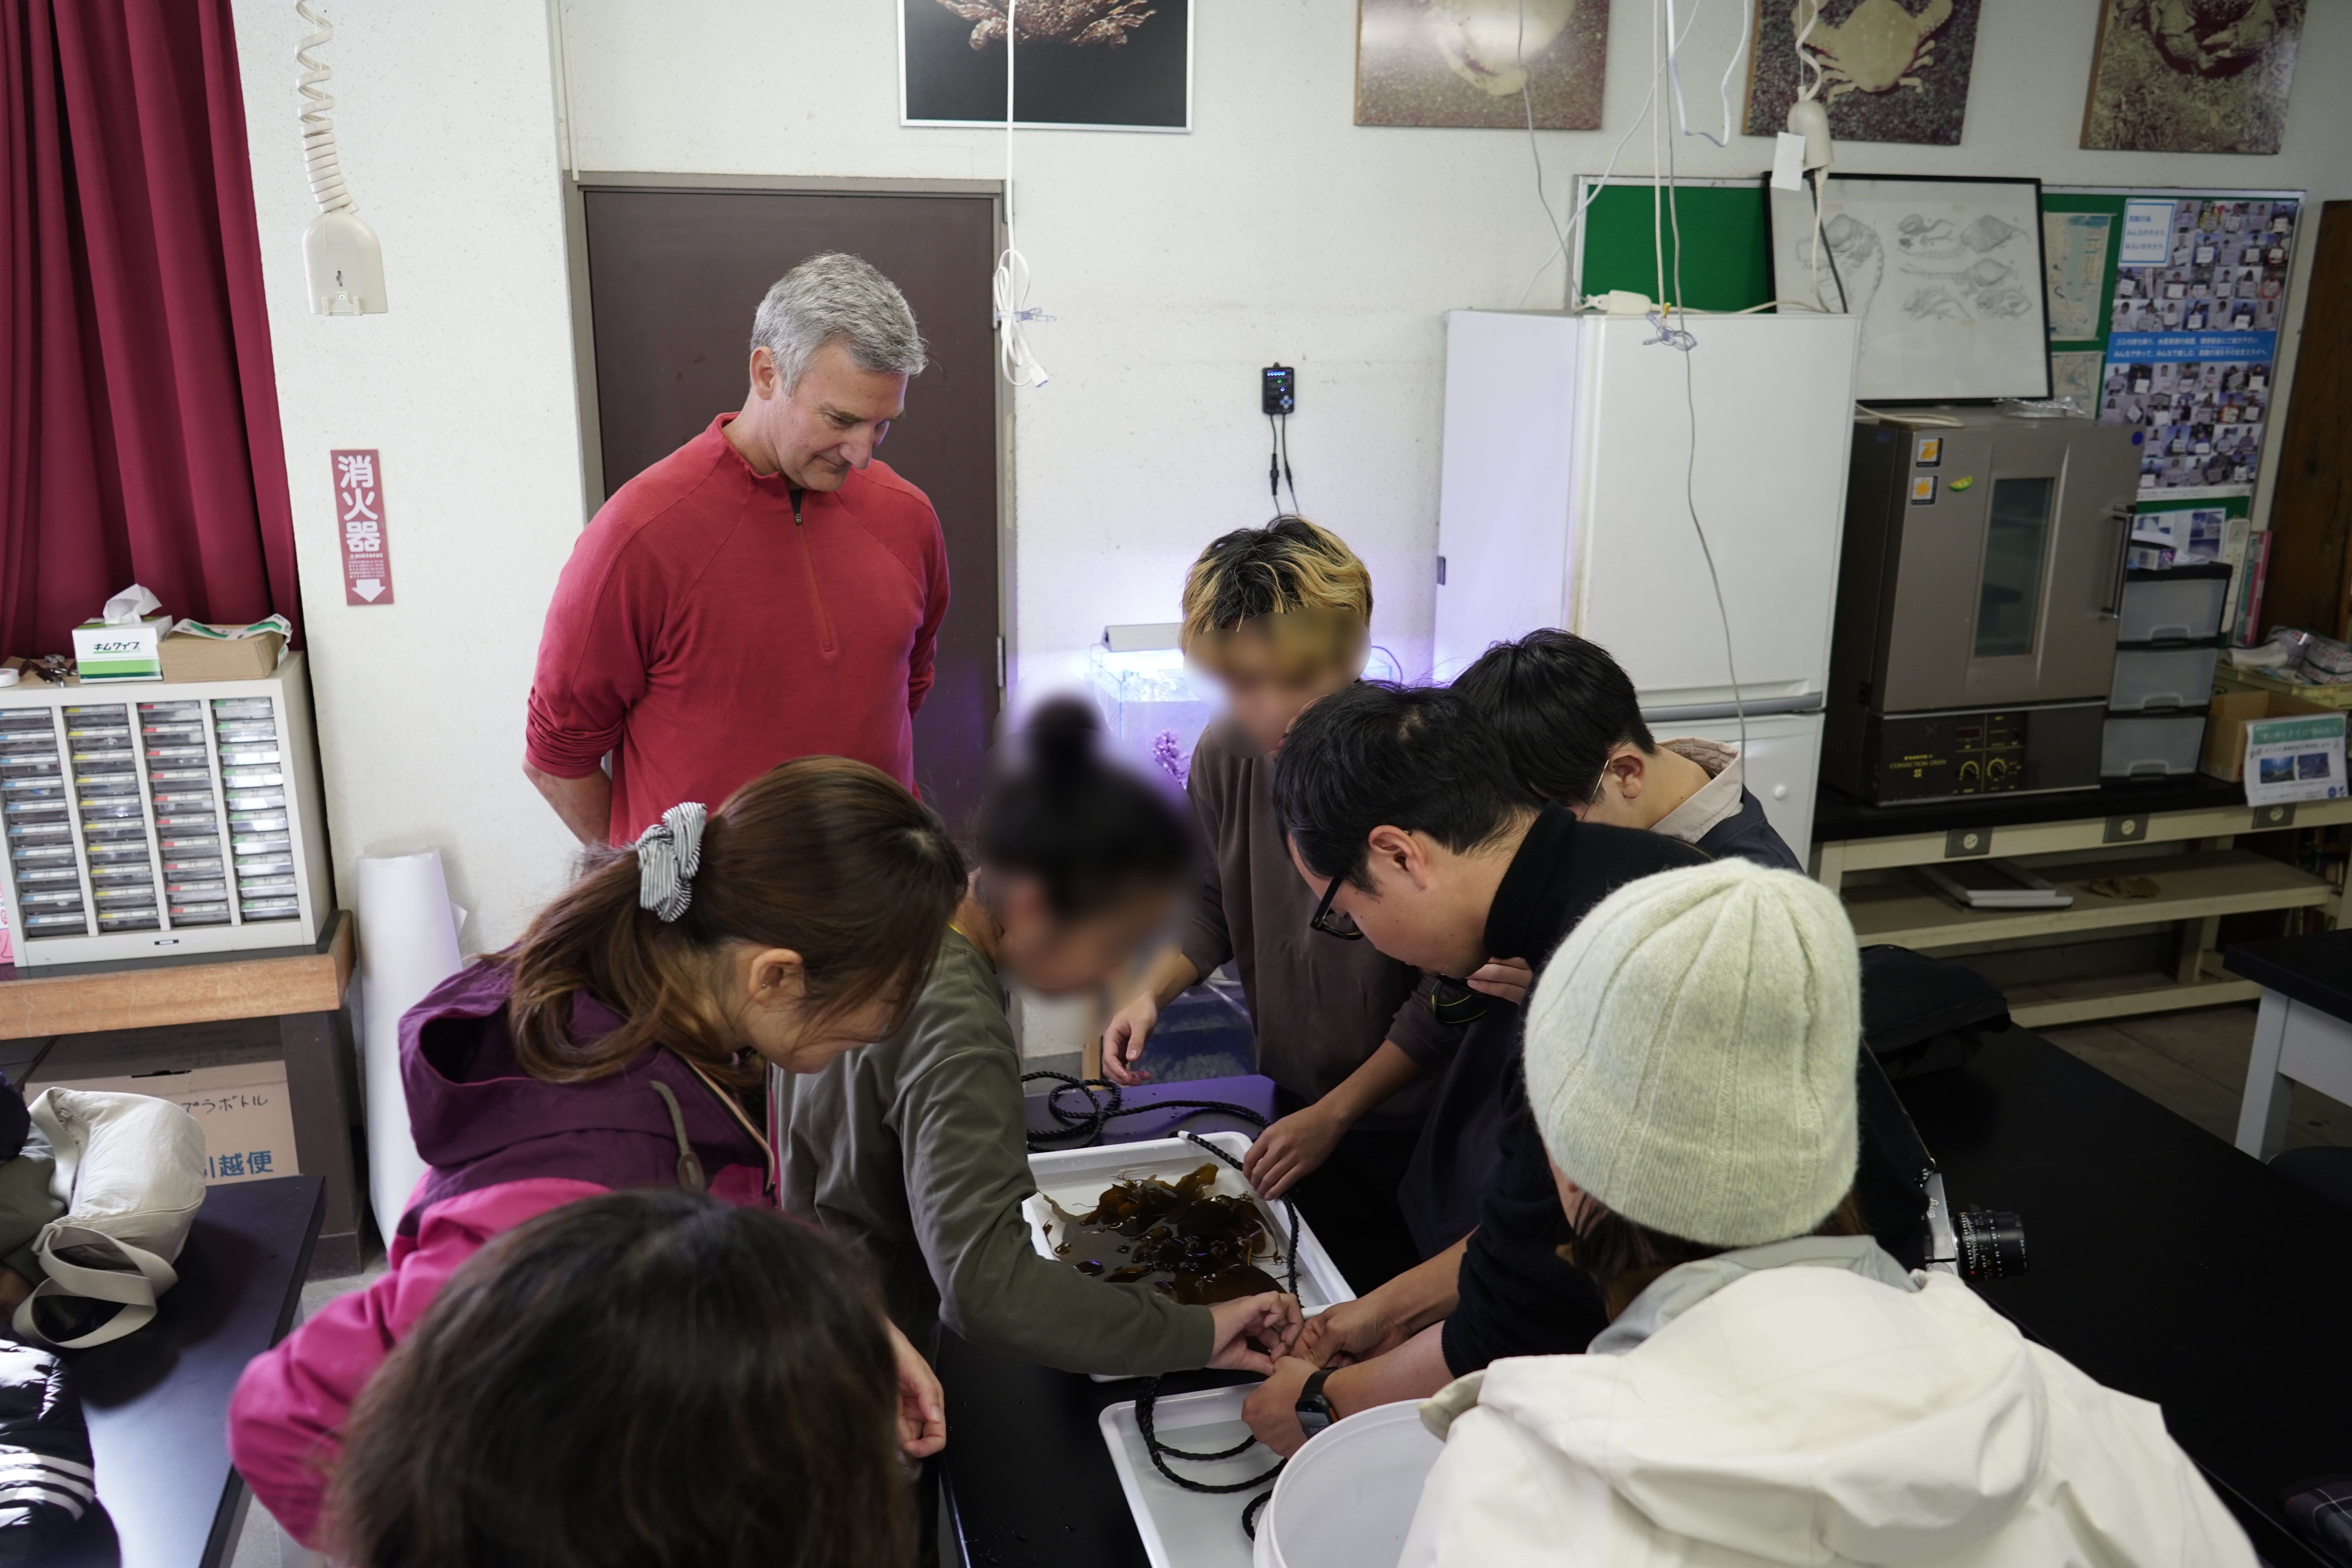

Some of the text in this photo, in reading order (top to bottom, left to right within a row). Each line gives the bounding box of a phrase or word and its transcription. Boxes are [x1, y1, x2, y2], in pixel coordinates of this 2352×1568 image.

[338, 455, 381, 552] 消火器
[181, 1095, 268, 1113] プラボトル
[204, 1151, 273, 1178] 越便
